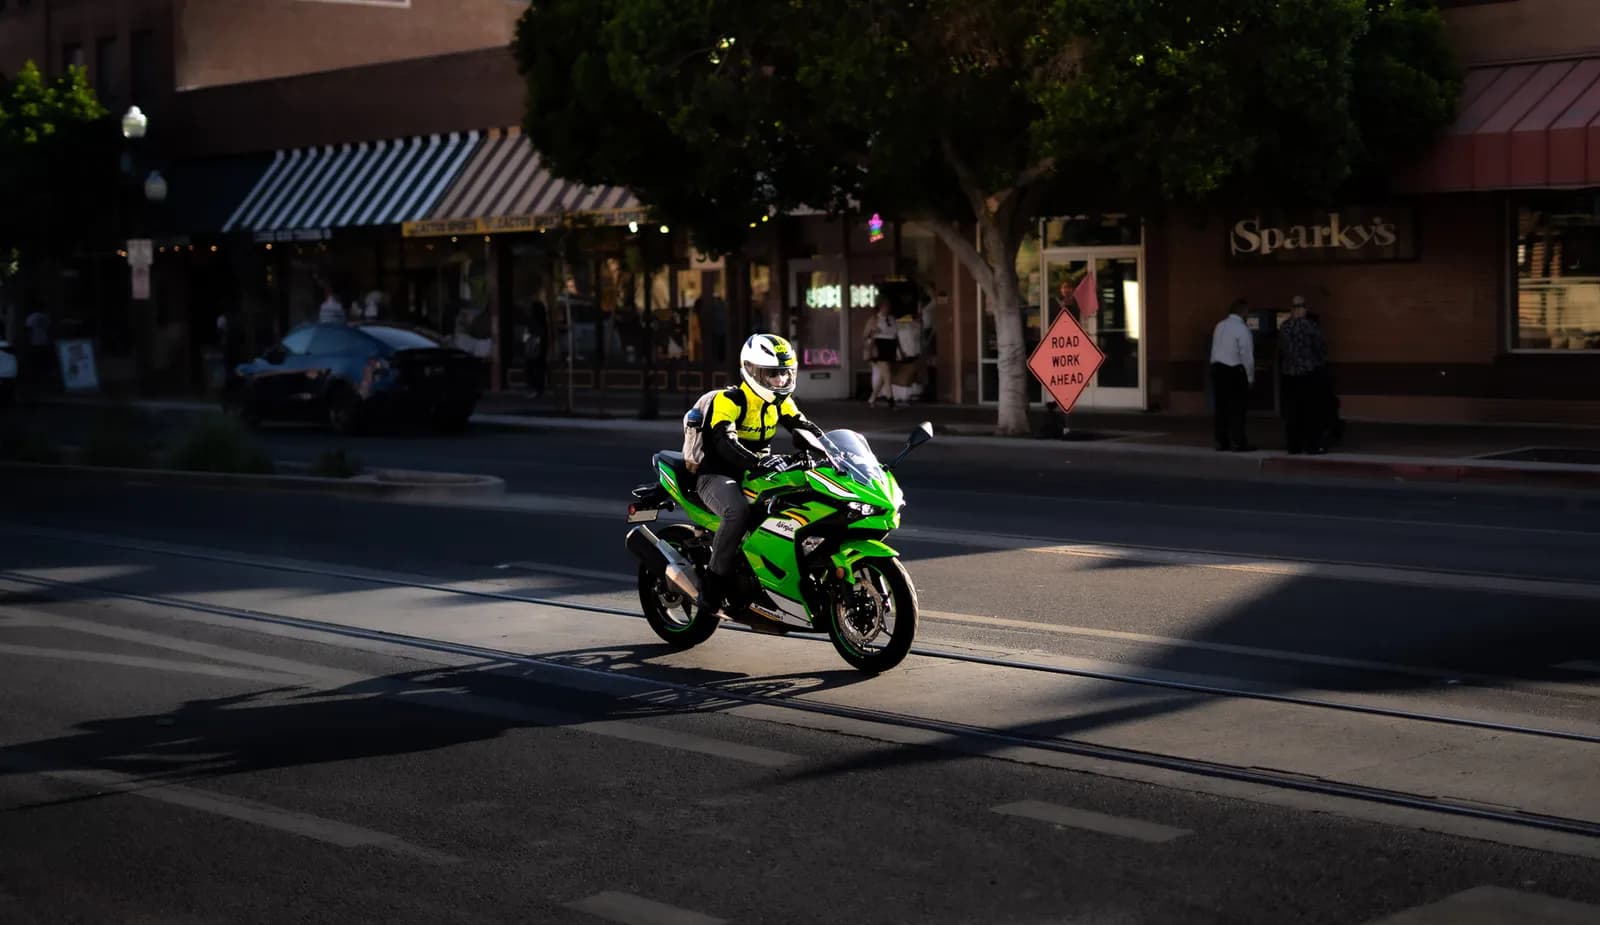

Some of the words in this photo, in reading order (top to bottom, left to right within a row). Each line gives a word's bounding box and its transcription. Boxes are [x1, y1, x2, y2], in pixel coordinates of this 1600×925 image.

[1230, 212, 1397, 256] Sparky's
[1051, 336, 1080, 349] ROAD
[1051, 354, 1080, 367] WORK
[1050, 372, 1084, 386] AHEAD
[776, 520, 794, 532] Ninja
